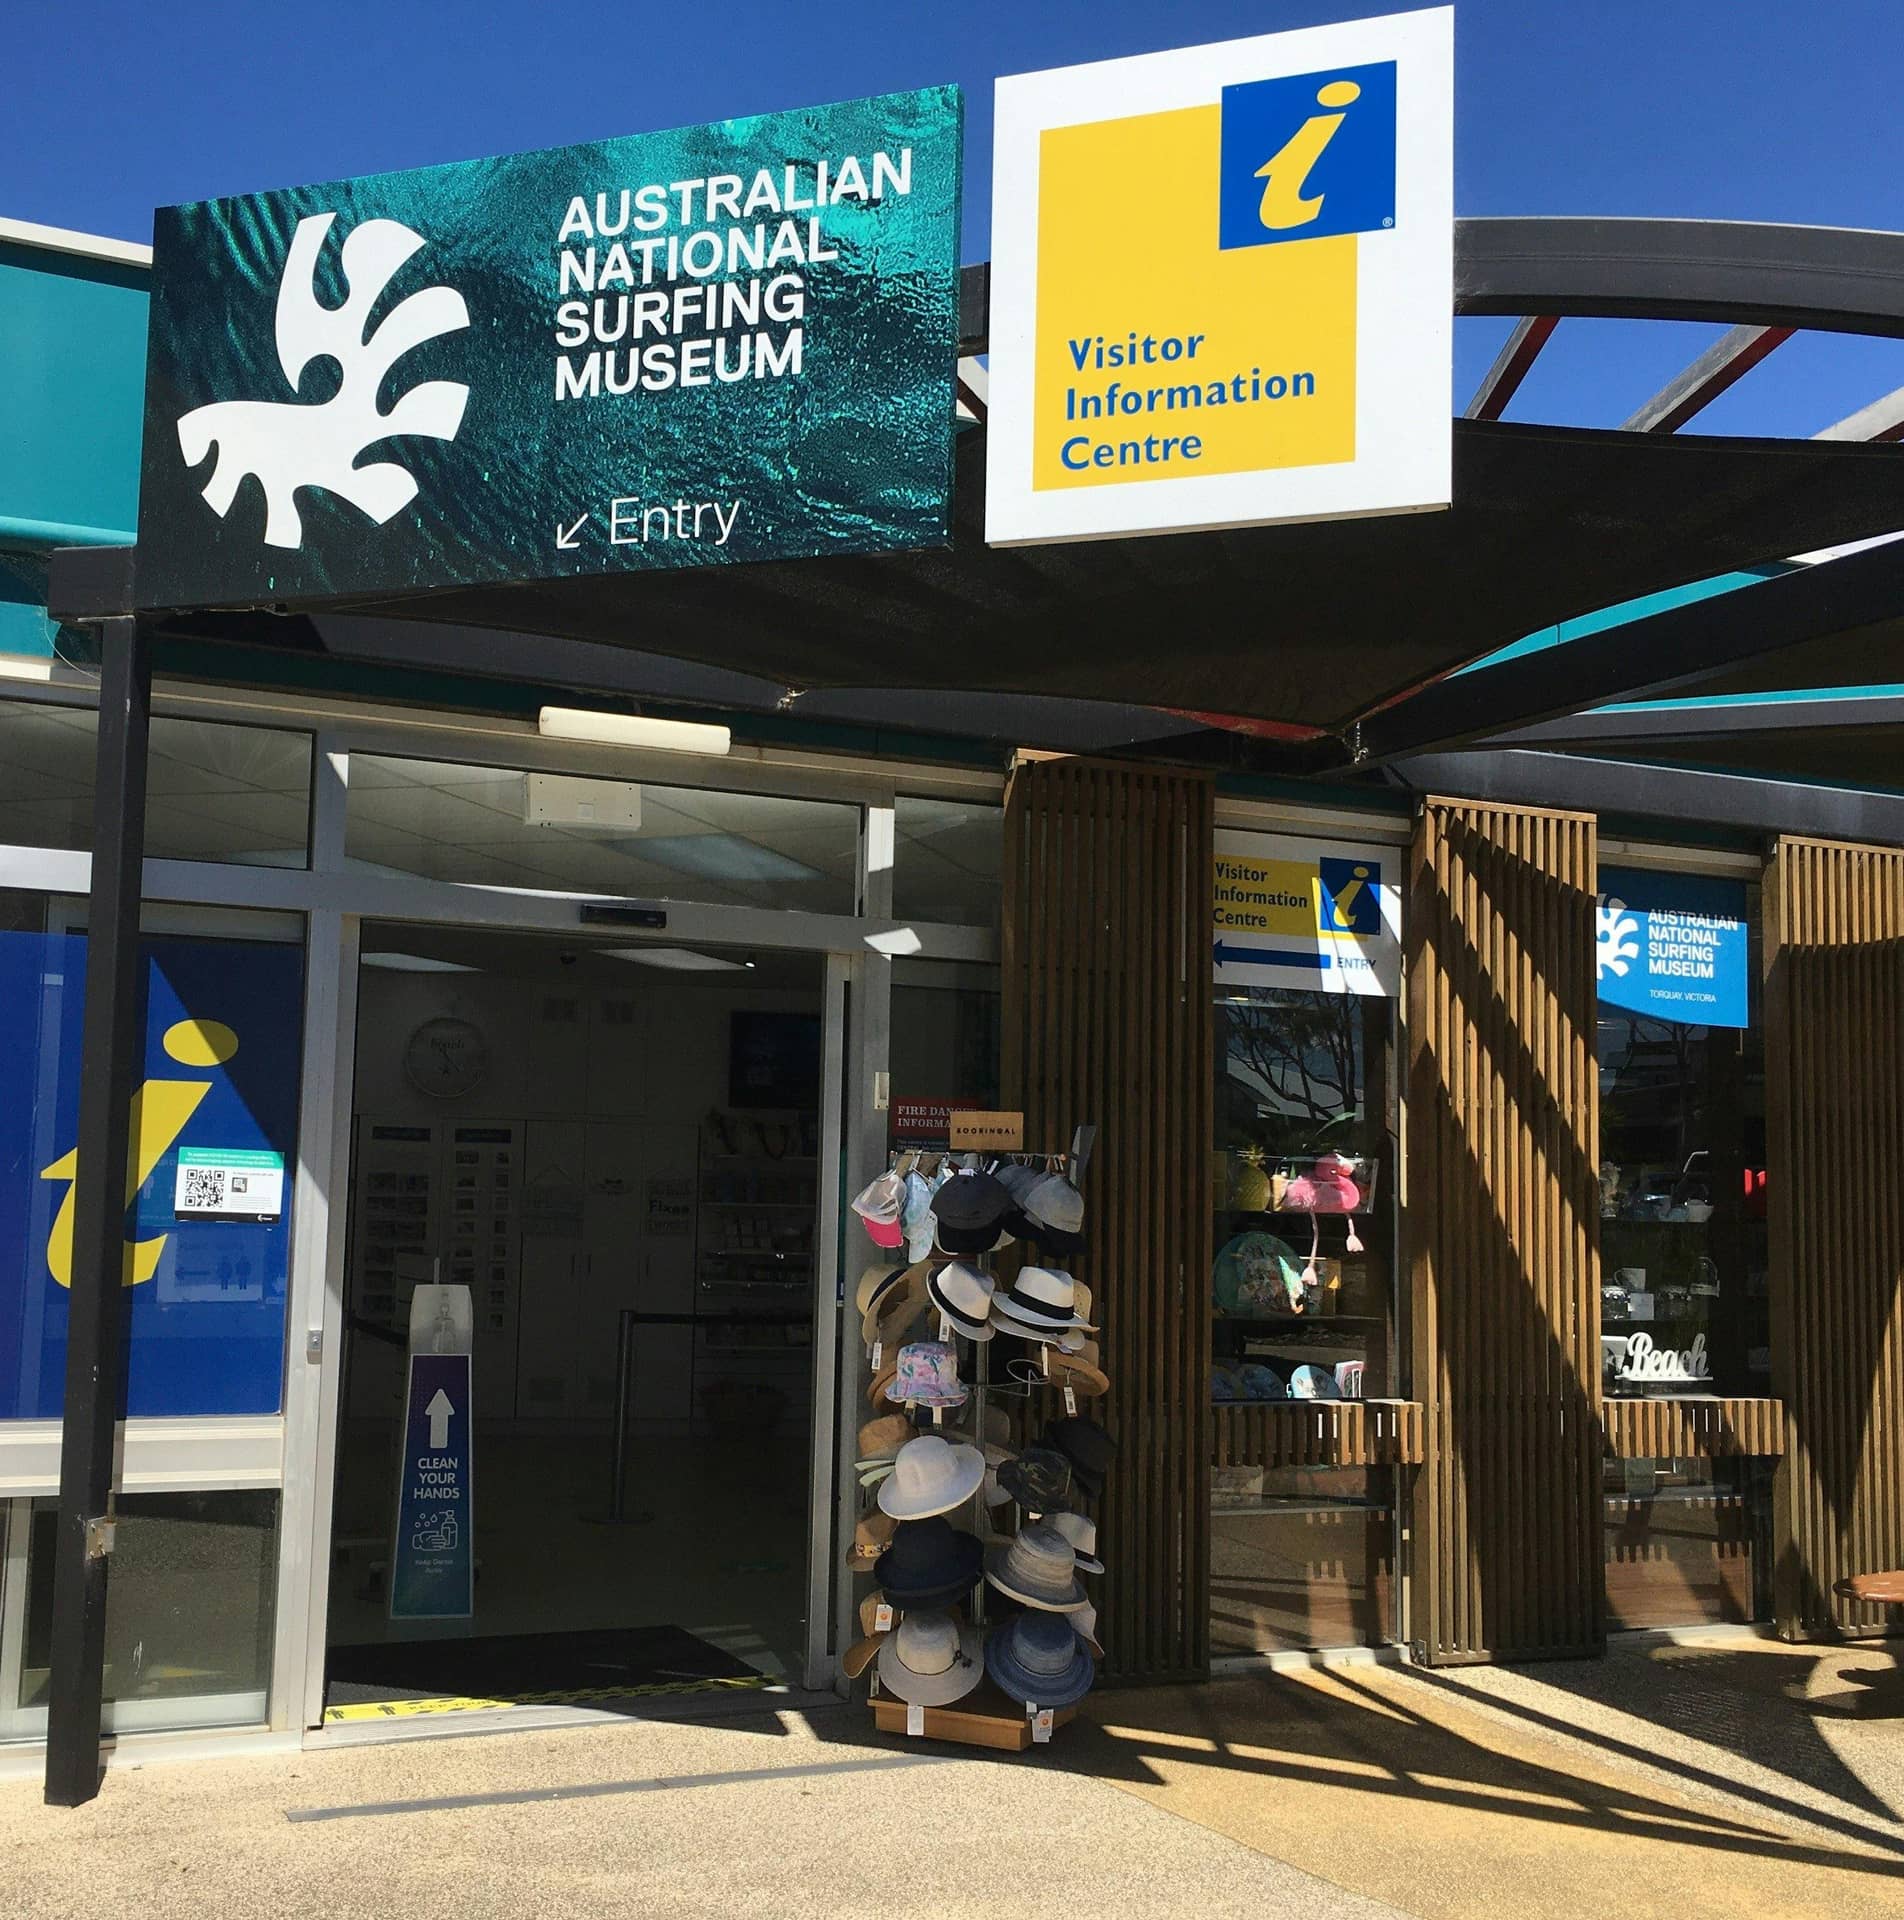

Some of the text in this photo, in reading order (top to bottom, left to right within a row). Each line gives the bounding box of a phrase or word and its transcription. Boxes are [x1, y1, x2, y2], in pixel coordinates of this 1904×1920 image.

[558, 148, 912, 242] AUSTRALIAN
[560, 216, 838, 295] NATIONAL
[555, 274, 804, 347] SURFING
[1069, 332, 1205, 371] Visitor
[555, 328, 802, 400] MUSEUM
[1066, 367, 1315, 421] Information
[1061, 434, 1202, 470] Centre
[610, 496, 740, 546] Entry
[1215, 862, 1268, 882] Visitor
[1214, 884, 1308, 908] Information
[1213, 907, 1267, 927] Centre
[1648, 908, 1738, 931] AUSTRALIAN
[1648, 924, 1722, 946] NATIONAL
[1648, 941, 1714, 962] SURFING
[1337, 957, 1377, 969] ENTRY
[1648, 958, 1714, 979] MUSEUM
[1684, 991, 1717, 1003] VICTORIA
[898, 1105, 927, 1116] FIRE
[898, 1118, 952, 1128] INFORMA
[1622, 1332, 1709, 1377] Beach
[418, 1457, 458, 1470] CLEAN
[419, 1473, 456, 1485] YOUR
[414, 1487, 460, 1500] HANDS
